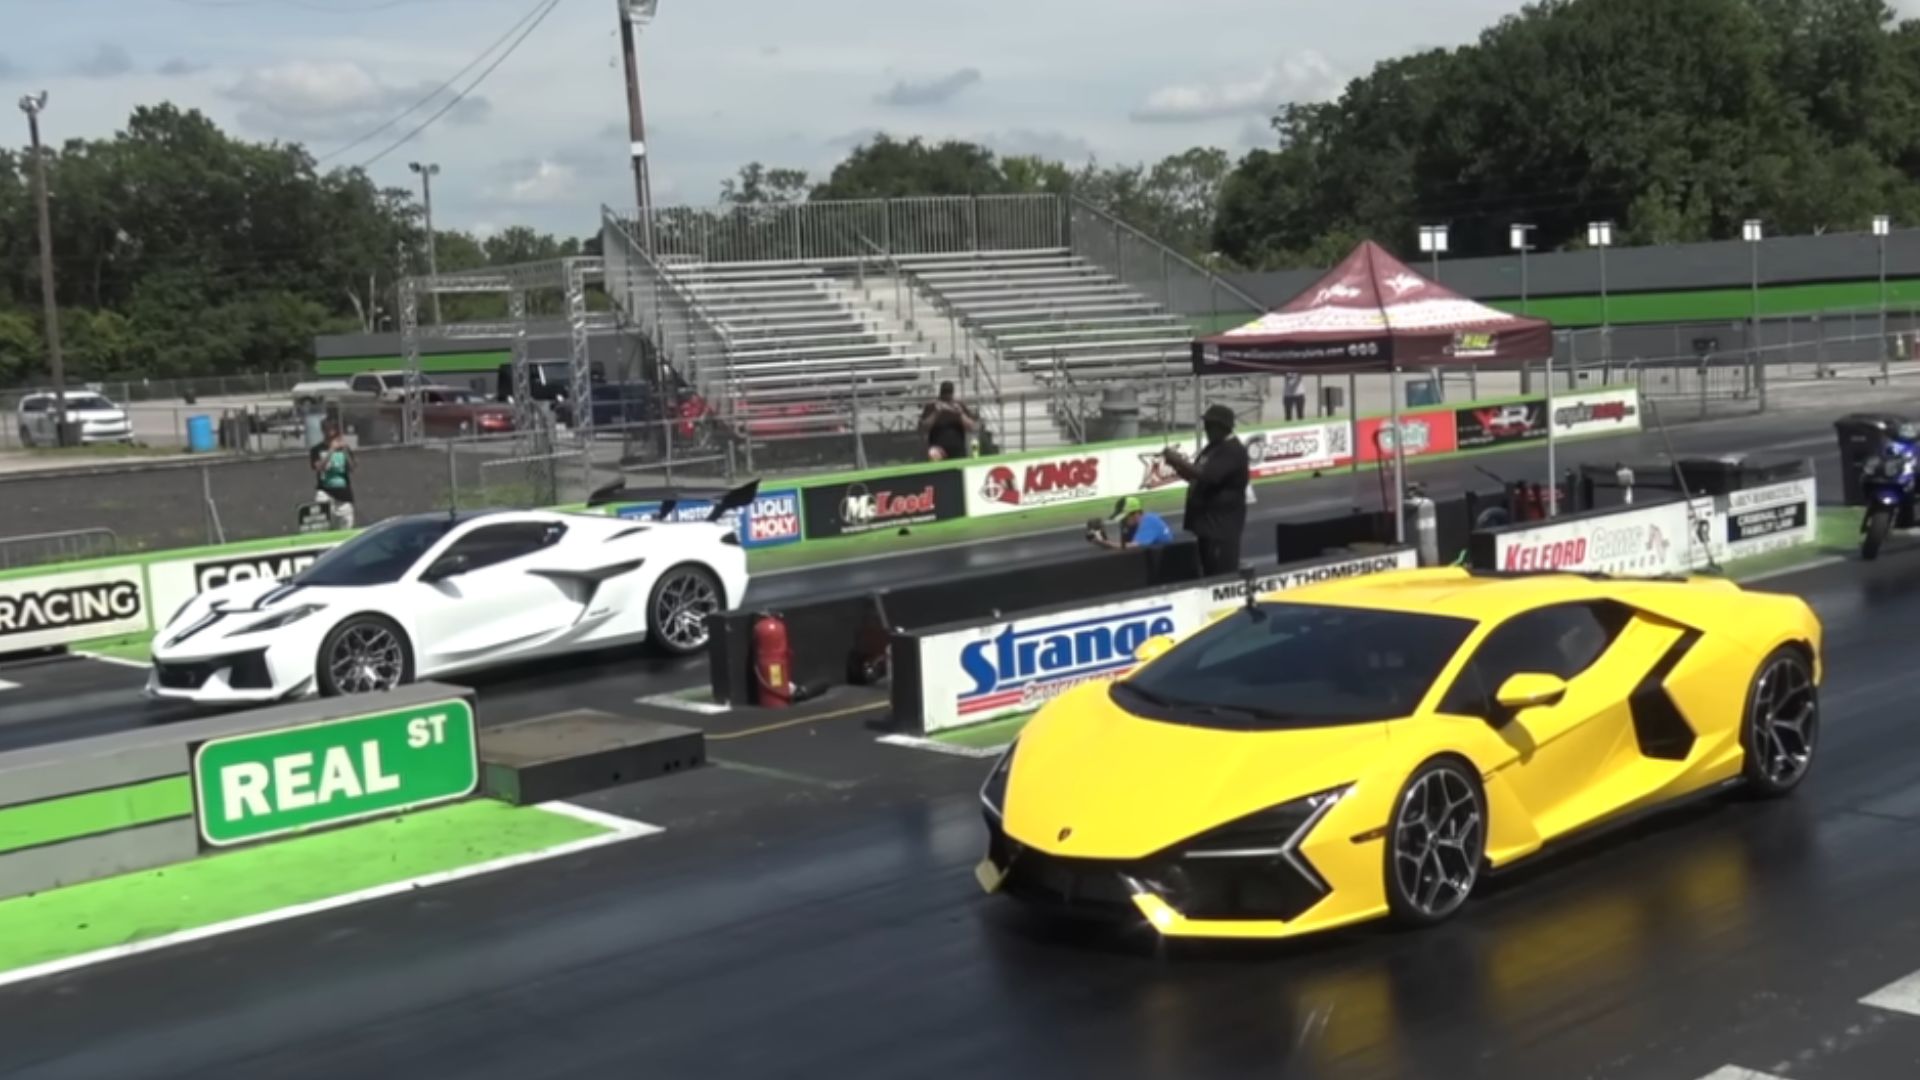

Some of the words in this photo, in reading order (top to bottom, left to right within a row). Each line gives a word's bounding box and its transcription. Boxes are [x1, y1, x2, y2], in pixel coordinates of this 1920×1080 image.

[1023, 457, 1098, 495] KINGS
[751, 498, 793, 518] LIQUI
[845, 486, 935, 520] McLeod
[753, 517, 797, 540] MOLY
[1505, 536, 1586, 571] KELFORD
[1213, 575, 1289, 602] MICKEY
[1294, 557, 1398, 586] THOMPSON
[0, 586, 137, 630] RACING
[960, 616, 1175, 696] Strange
[220, 740, 400, 821] REAL
[407, 714, 447, 748] ST
